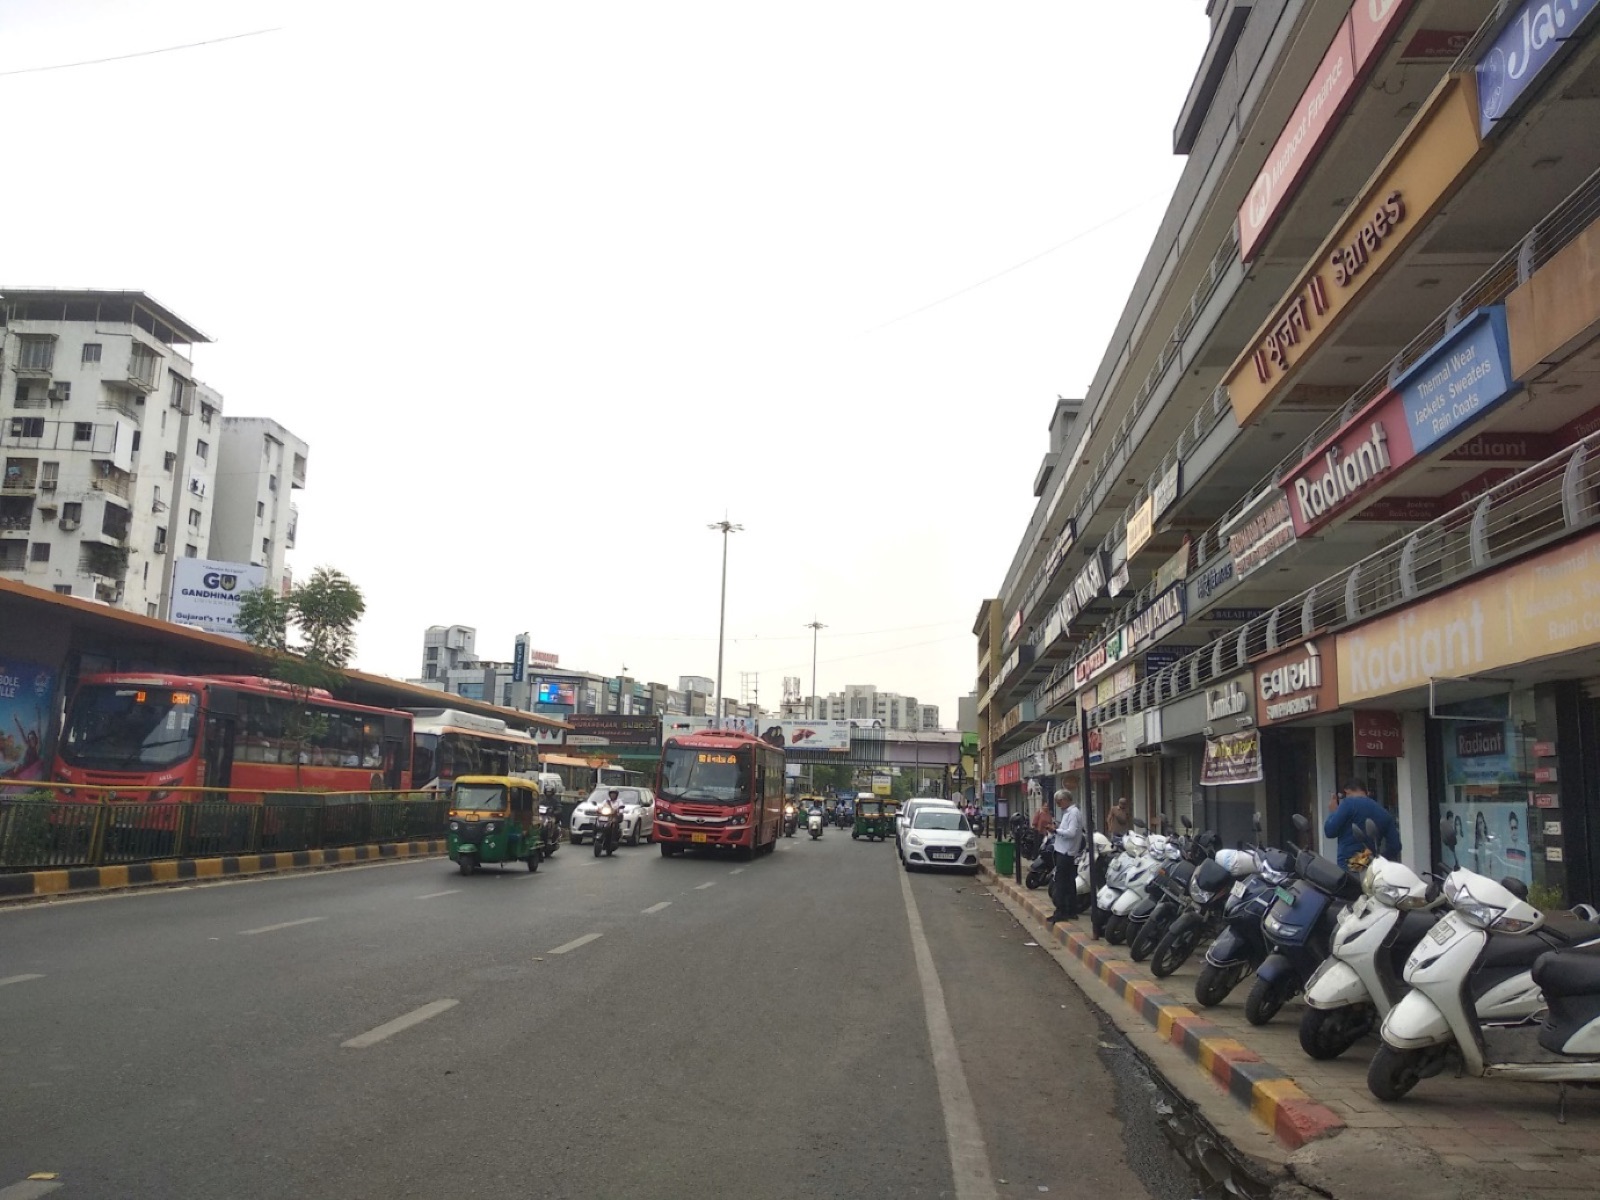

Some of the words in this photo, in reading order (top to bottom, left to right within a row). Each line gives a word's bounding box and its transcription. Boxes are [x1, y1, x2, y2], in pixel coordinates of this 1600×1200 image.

[1272, 117, 1308, 189] Muthoot
[1307, 56, 1344, 128] Finance
[1330, 189, 1406, 288] Sarees
[1415, 394, 1446, 425] Jackets
[1448, 360, 1491, 398] Sweaters
[1417, 362, 1451, 399] Thermal
[1450, 345, 1476, 372] Wear
[1432, 412, 1452, 435] Rain
[1452, 393, 1479, 419] Coats
[1295, 422, 1391, 523] Radiant
[175, 612, 213, 622] Gujarat's
[181, 588, 240, 601] GANDHINAG
[1351, 602, 1485, 694] Radiant
[1548, 617, 1578, 641] Rain
[1458, 732, 1502, 755] Radiant
